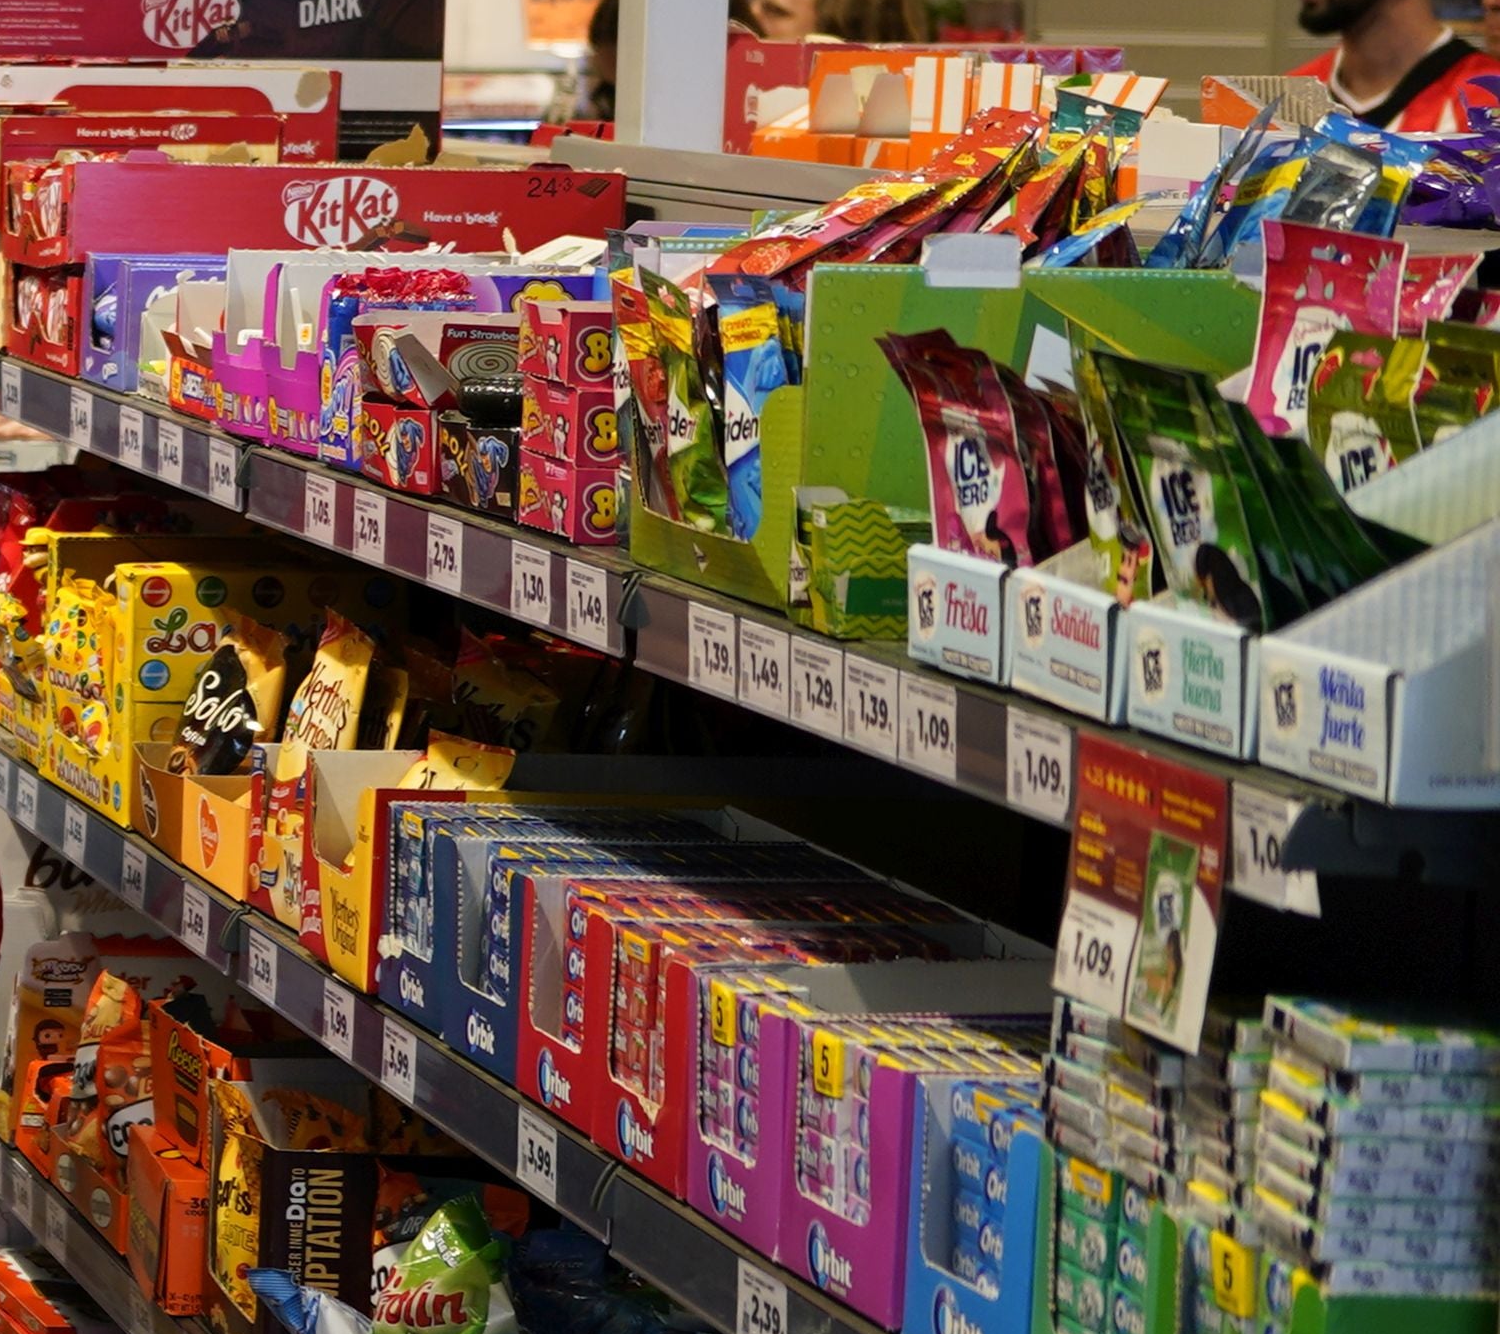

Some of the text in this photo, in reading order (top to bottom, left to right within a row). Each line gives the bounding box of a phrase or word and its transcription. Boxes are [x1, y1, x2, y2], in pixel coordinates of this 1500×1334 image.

[298, 178, 396, 244] KitKat
[423, 211, 463, 224] Have a
[447, 329, 467, 340] Fun
[1160, 469, 1199, 515] ICE
[945, 582, 990, 636] Fresa
[399, 969, 426, 1009] Orbit
[714, 996, 725, 1028] 5
[465, 1012, 496, 1057] Orbit
[817, 1048, 831, 1077] 5
[706, 1151, 747, 1218] Orbit
[806, 1220, 853, 1292] Orbit
[1222, 1252, 1234, 1290] 5
